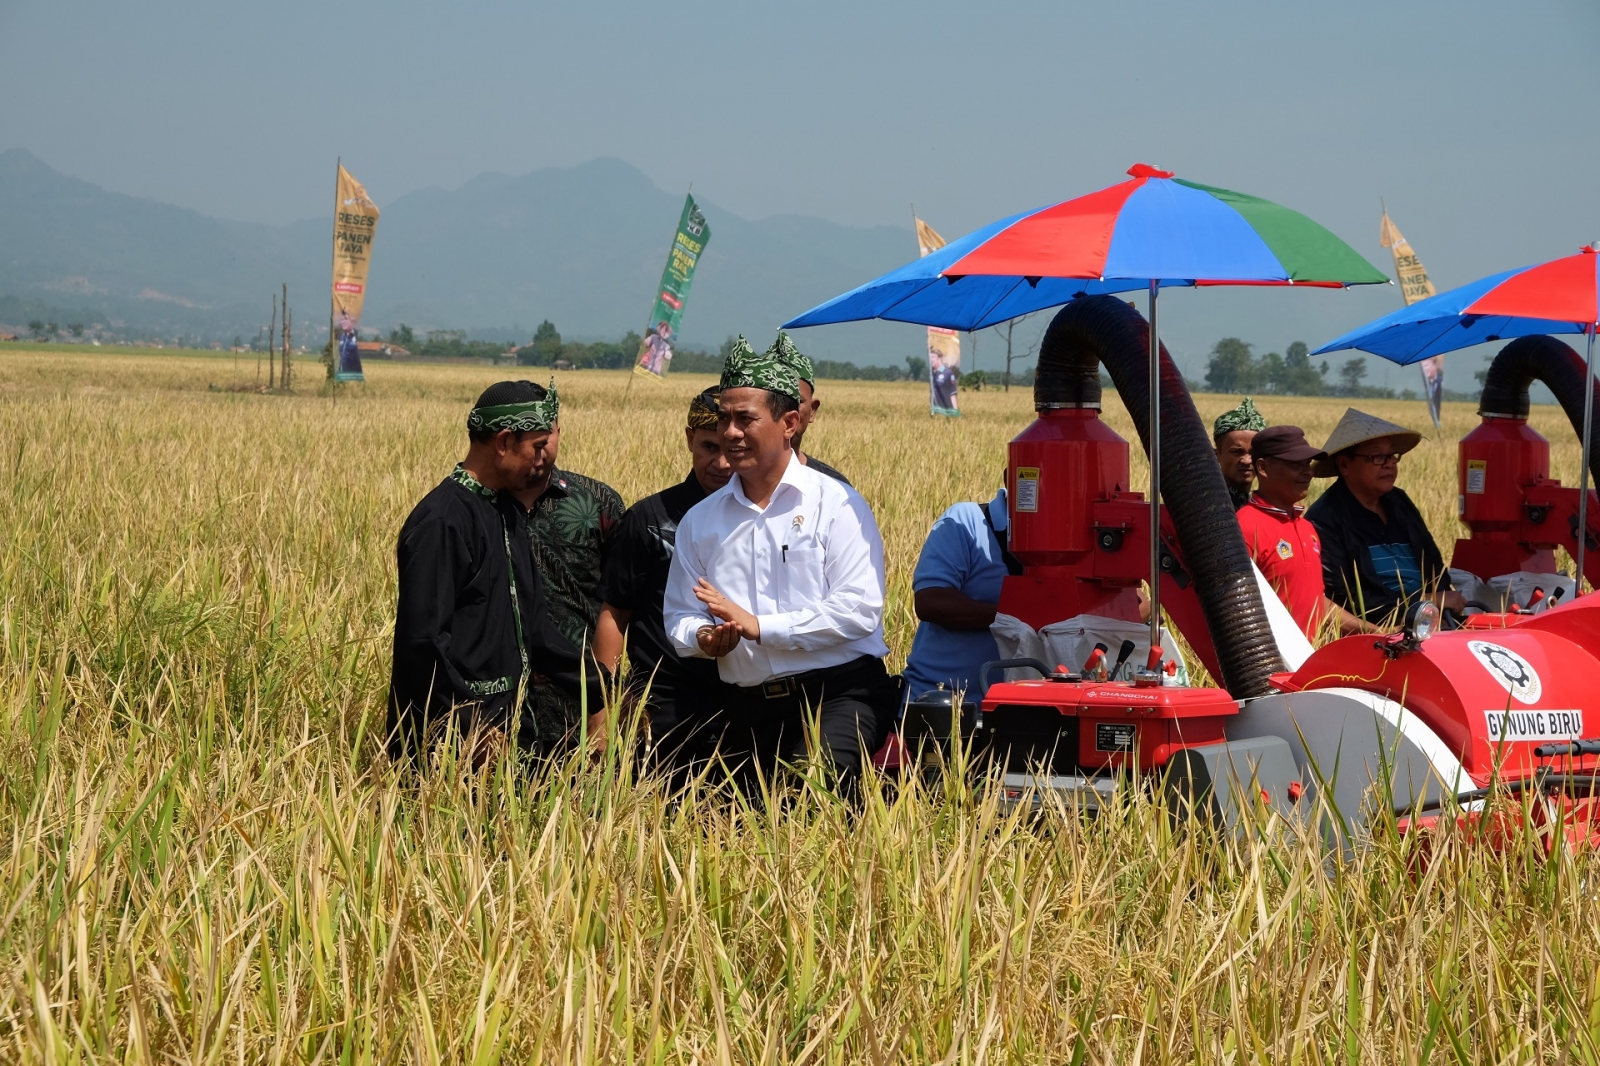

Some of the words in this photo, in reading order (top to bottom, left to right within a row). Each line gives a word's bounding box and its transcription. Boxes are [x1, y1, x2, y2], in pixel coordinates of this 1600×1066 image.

[338, 212, 374, 226] RESES
[336, 231, 371, 245] PANEN
[1397, 255, 1420, 267] ESE
[1100, 691, 1158, 700] CHANGCHAI
[1488, 712, 1545, 736] GUNUNG
[1548, 712, 1581, 735] BIRU
